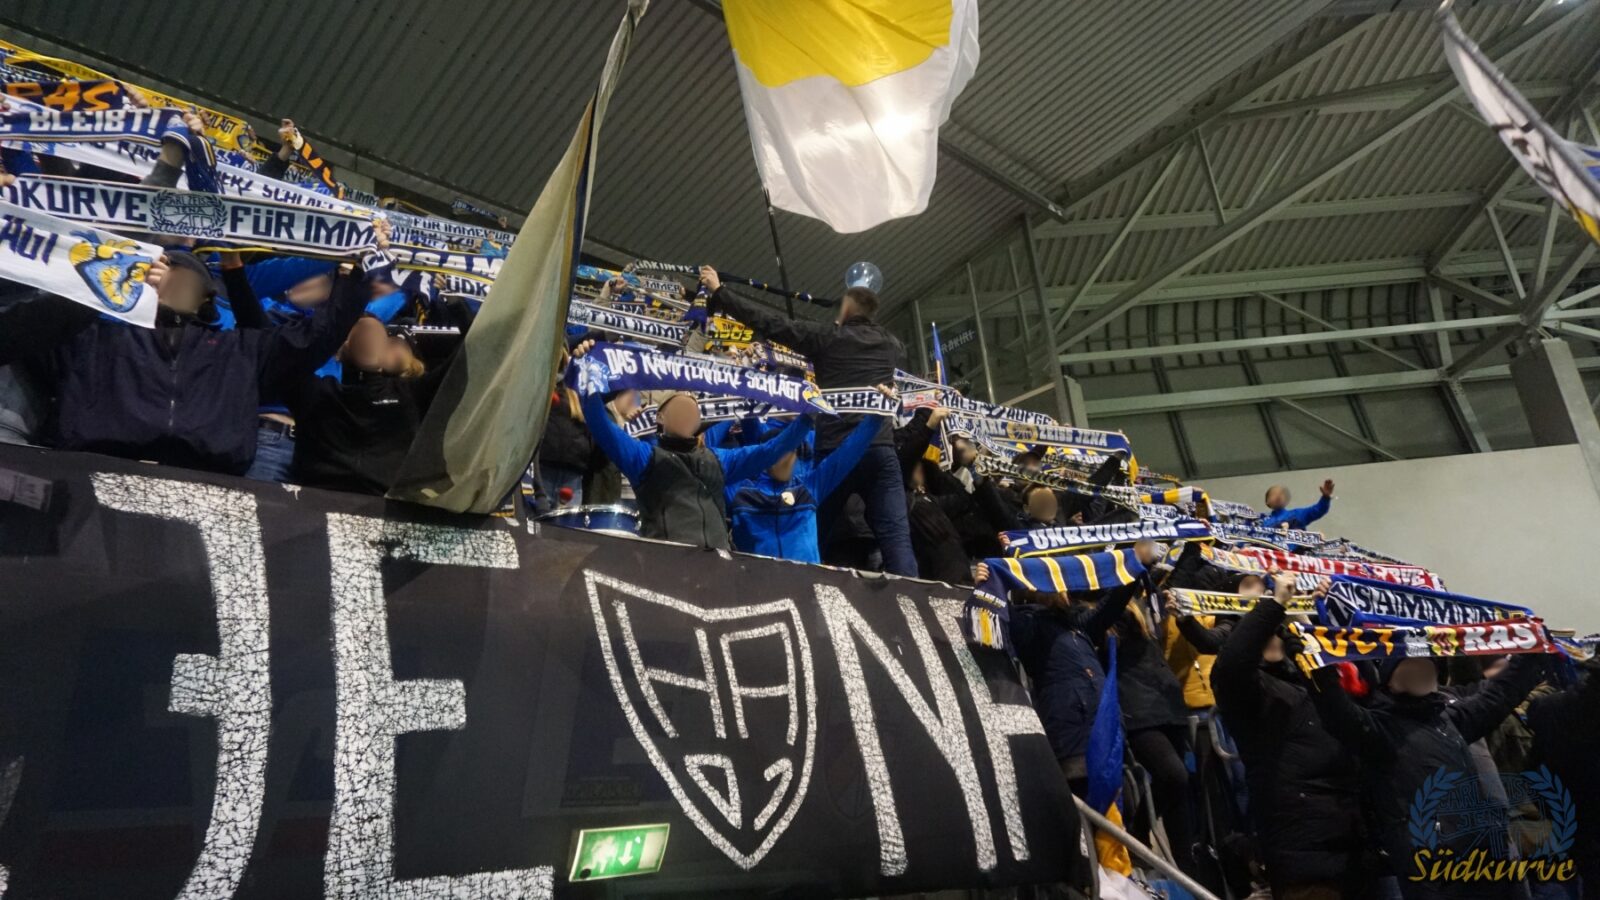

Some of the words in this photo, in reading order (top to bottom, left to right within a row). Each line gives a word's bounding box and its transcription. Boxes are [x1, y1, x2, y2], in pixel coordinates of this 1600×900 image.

[29, 109, 162, 135] BLEIBT!
[230, 204, 296, 240] FÜR
[590, 310, 628, 329] FÜR
[603, 349, 637, 375] DAS
[640, 350, 742, 391] KÄMPFERHERZ
[745, 368, 803, 403] SCHLÄGT
[1039, 426, 1073, 442] ZEISS
[1074, 429, 1108, 447] JENA
[1027, 519, 1179, 551] UNBEUGSAM
